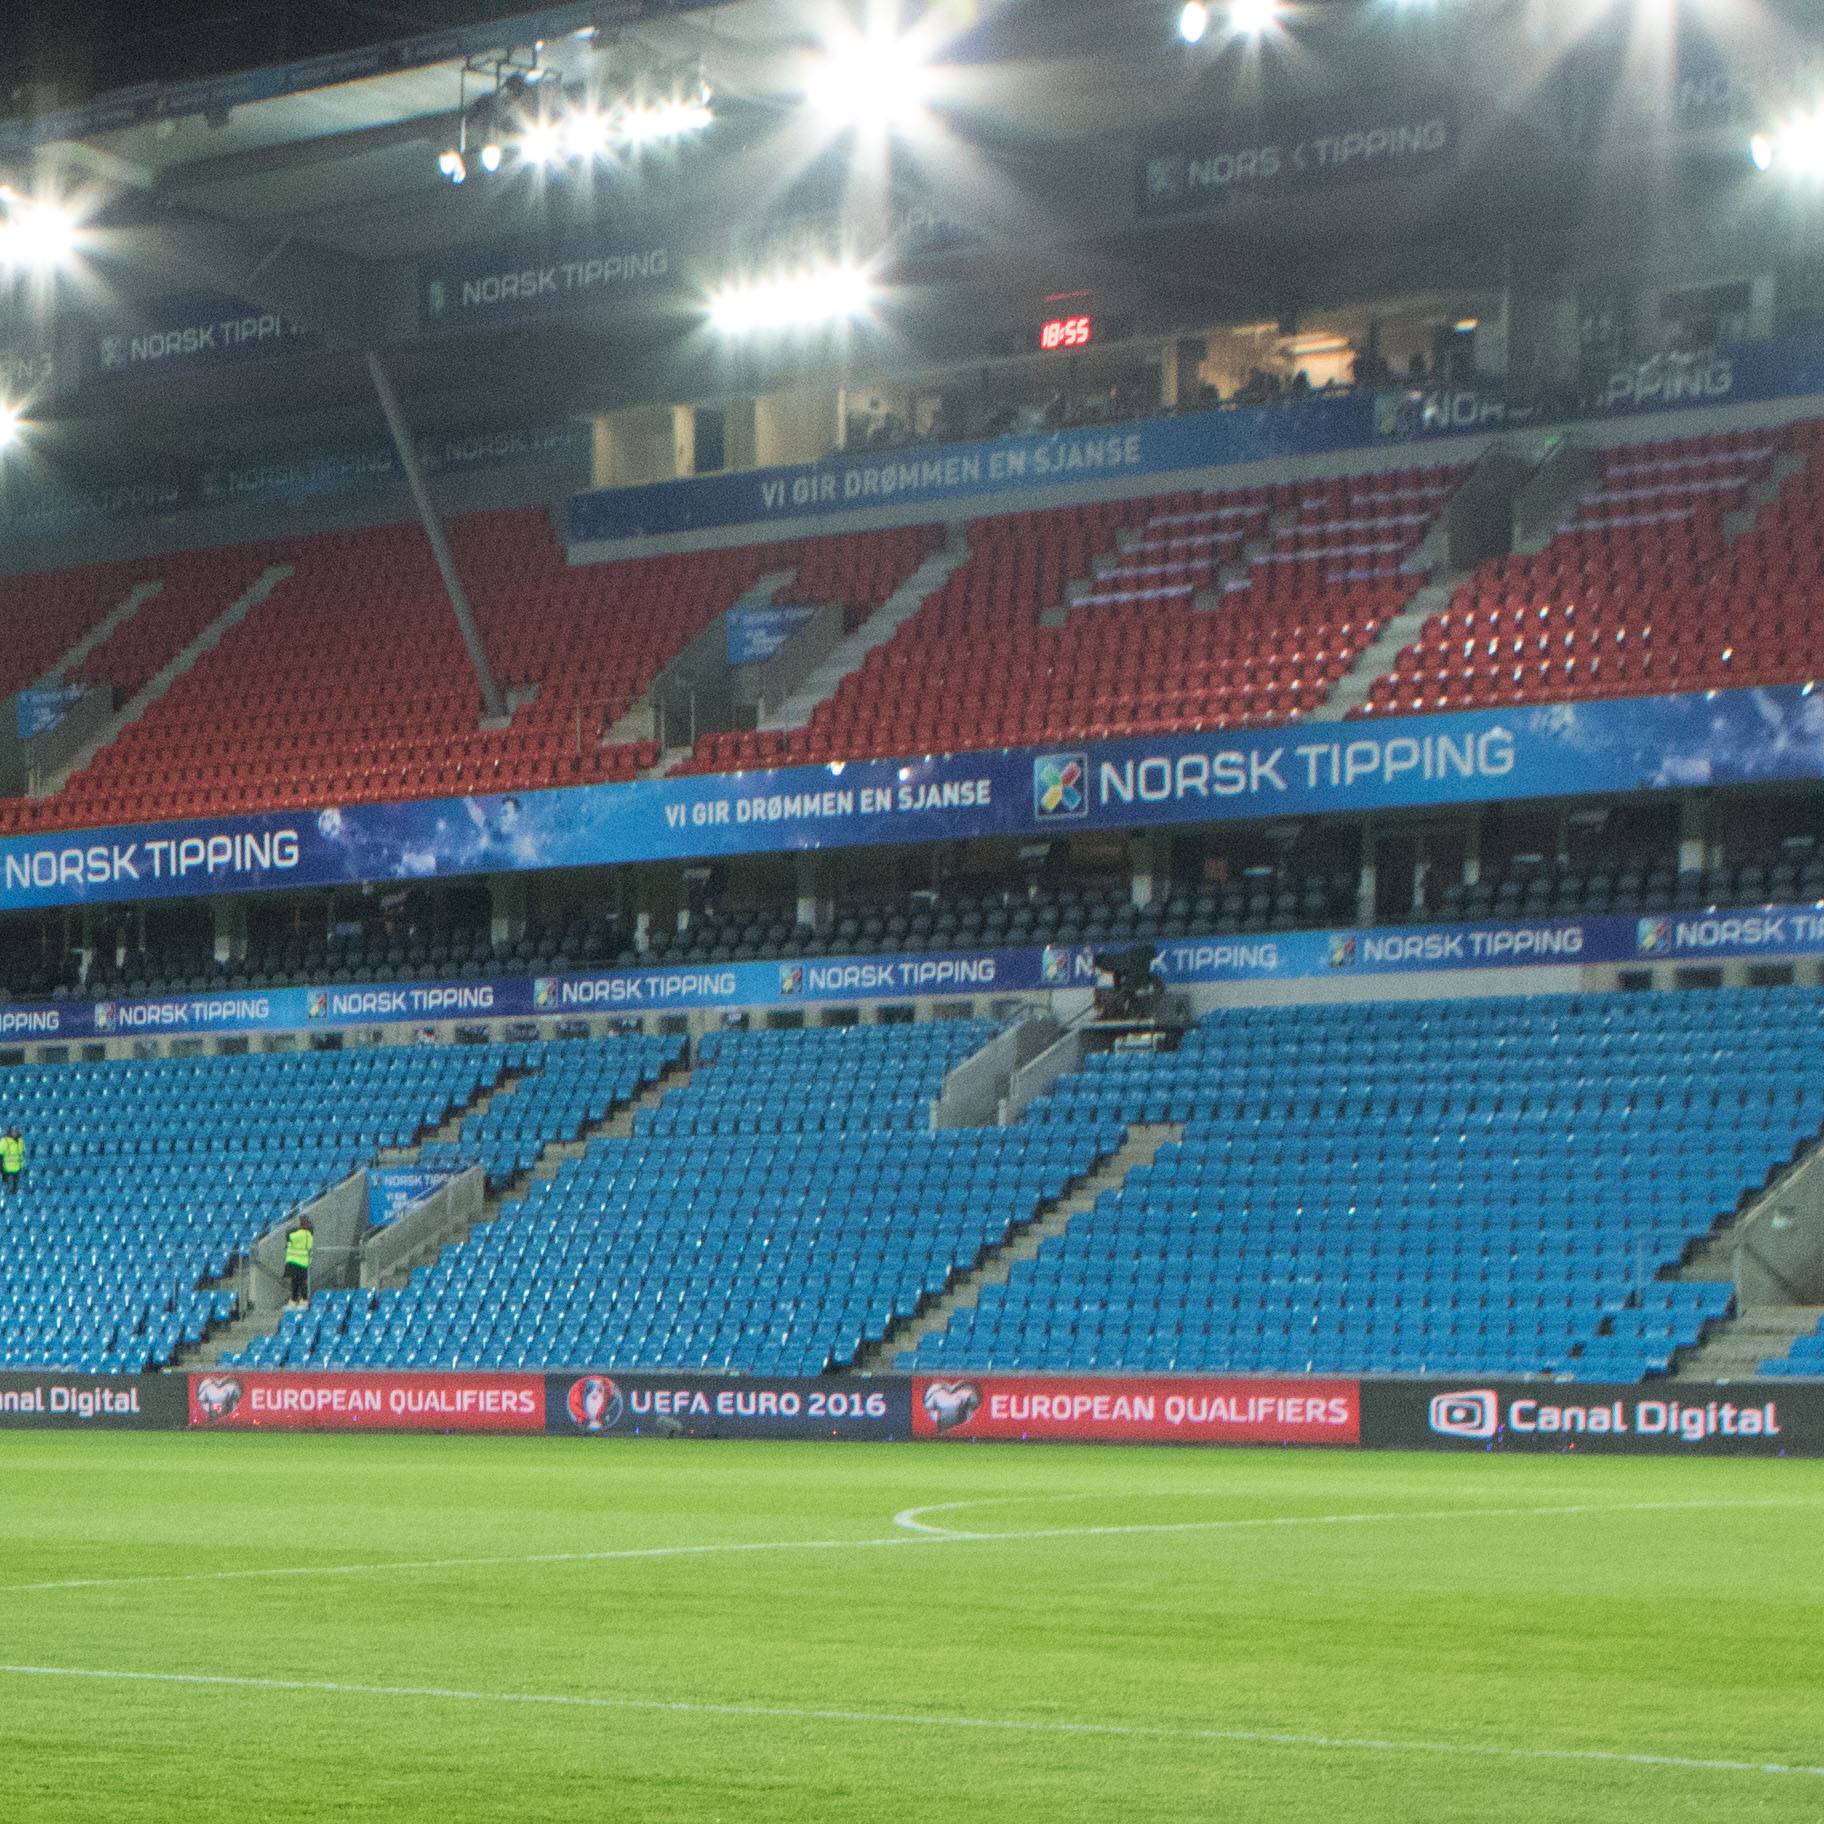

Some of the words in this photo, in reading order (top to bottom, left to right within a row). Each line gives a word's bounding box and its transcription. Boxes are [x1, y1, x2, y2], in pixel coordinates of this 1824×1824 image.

[462, 269, 557, 306] NORSK
[561, 248, 669, 290] TIPPING
[131, 324, 216, 361] NORSK
[1040, 315, 1092, 350] 18:55
[762, 480, 786, 508] VI
[792, 474, 835, 503] GIR
[844, 457, 982, 499] DRØMMEN
[990, 450, 1026, 481] EN
[1034, 433, 1140, 473] SJANSE
[1101, 747, 1288, 805] NORSK
[1294, 727, 1516, 786] TIPPING
[665, 803, 687, 829] VI
[692, 800, 731, 826] GIR
[736, 789, 854, 824] DRØMMEN
[860, 788, 893, 814] EN
[897, 778, 992, 811] SJANSE
[5, 842, 141, 889] NORSK
[144, 829, 300, 879] TIPPING
[1362, 937, 1464, 962] NORSK
[1468, 928, 1584, 955] TIPPING
[1675, 917, 1785, 946] NORSK
[1172, 945, 1278, 971] TIPPING
[561, 979, 641, 1003] NORSK
[644, 972, 737, 997] TIPPING
[809, 966, 895, 991] NORSK
[898, 960, 996, 985] TIPPING
[118, 1006, 188, 1026] NORSK
[192, 999, 269, 1021] TIPPING
[332, 991, 407, 1015] NORSK
[410, 986, 495, 1010] TIPPING
[49, 1385, 141, 1418] Digital
[251, 1388, 381, 1413] EUROPEAN
[389, 1386, 535, 1417] QUALIFIERS
[630, 1390, 709, 1415] UEFA
[715, 1390, 801, 1417] EURO
[807, 1390, 887, 1419] 2016
[989, 1393, 1155, 1422] EUROPEAN
[1163, 1394, 1349, 1427] QUALIFIERS
[1508, 1399, 1627, 1435] Canal
[1635, 1400, 1781, 1442] Digital
